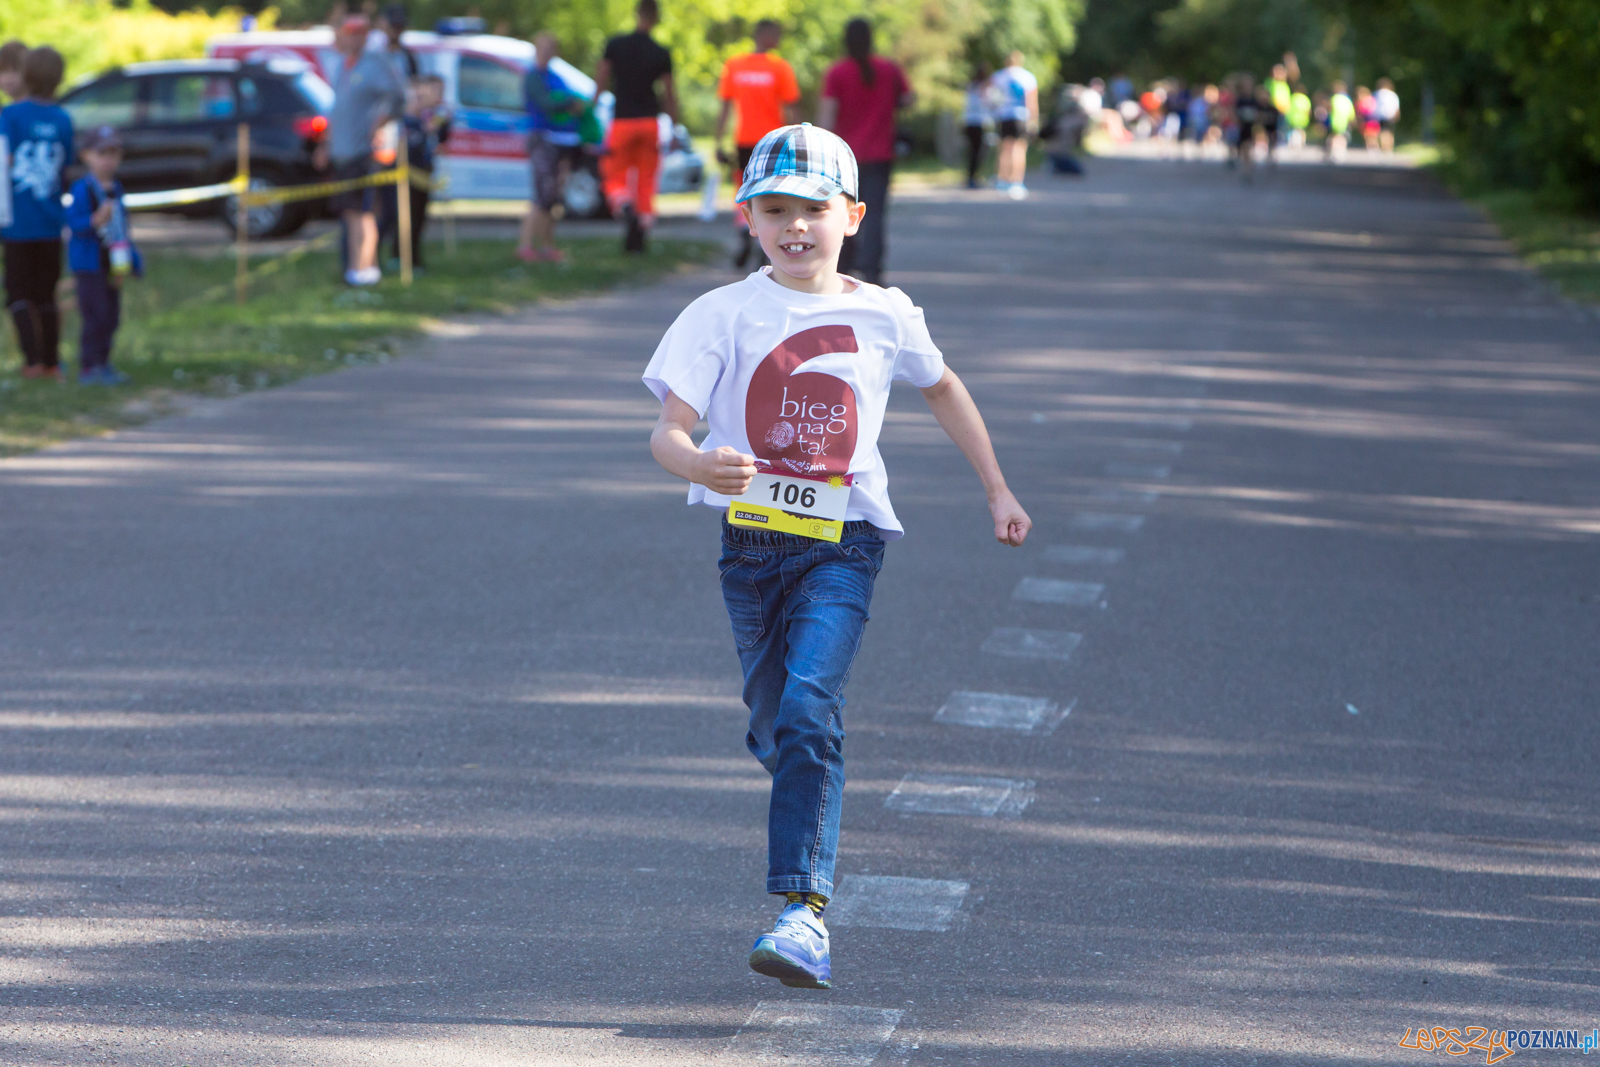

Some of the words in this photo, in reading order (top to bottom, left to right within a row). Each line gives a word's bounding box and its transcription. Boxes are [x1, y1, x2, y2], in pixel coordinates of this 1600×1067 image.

[745, 325, 859, 475] 6
[779, 386, 847, 434] bieg
[797, 422, 824, 435] na
[796, 434, 830, 456] tak
[804, 462, 827, 474] Spirit
[769, 481, 817, 508] 106
[736, 511, 768, 523] 22.06.2018
